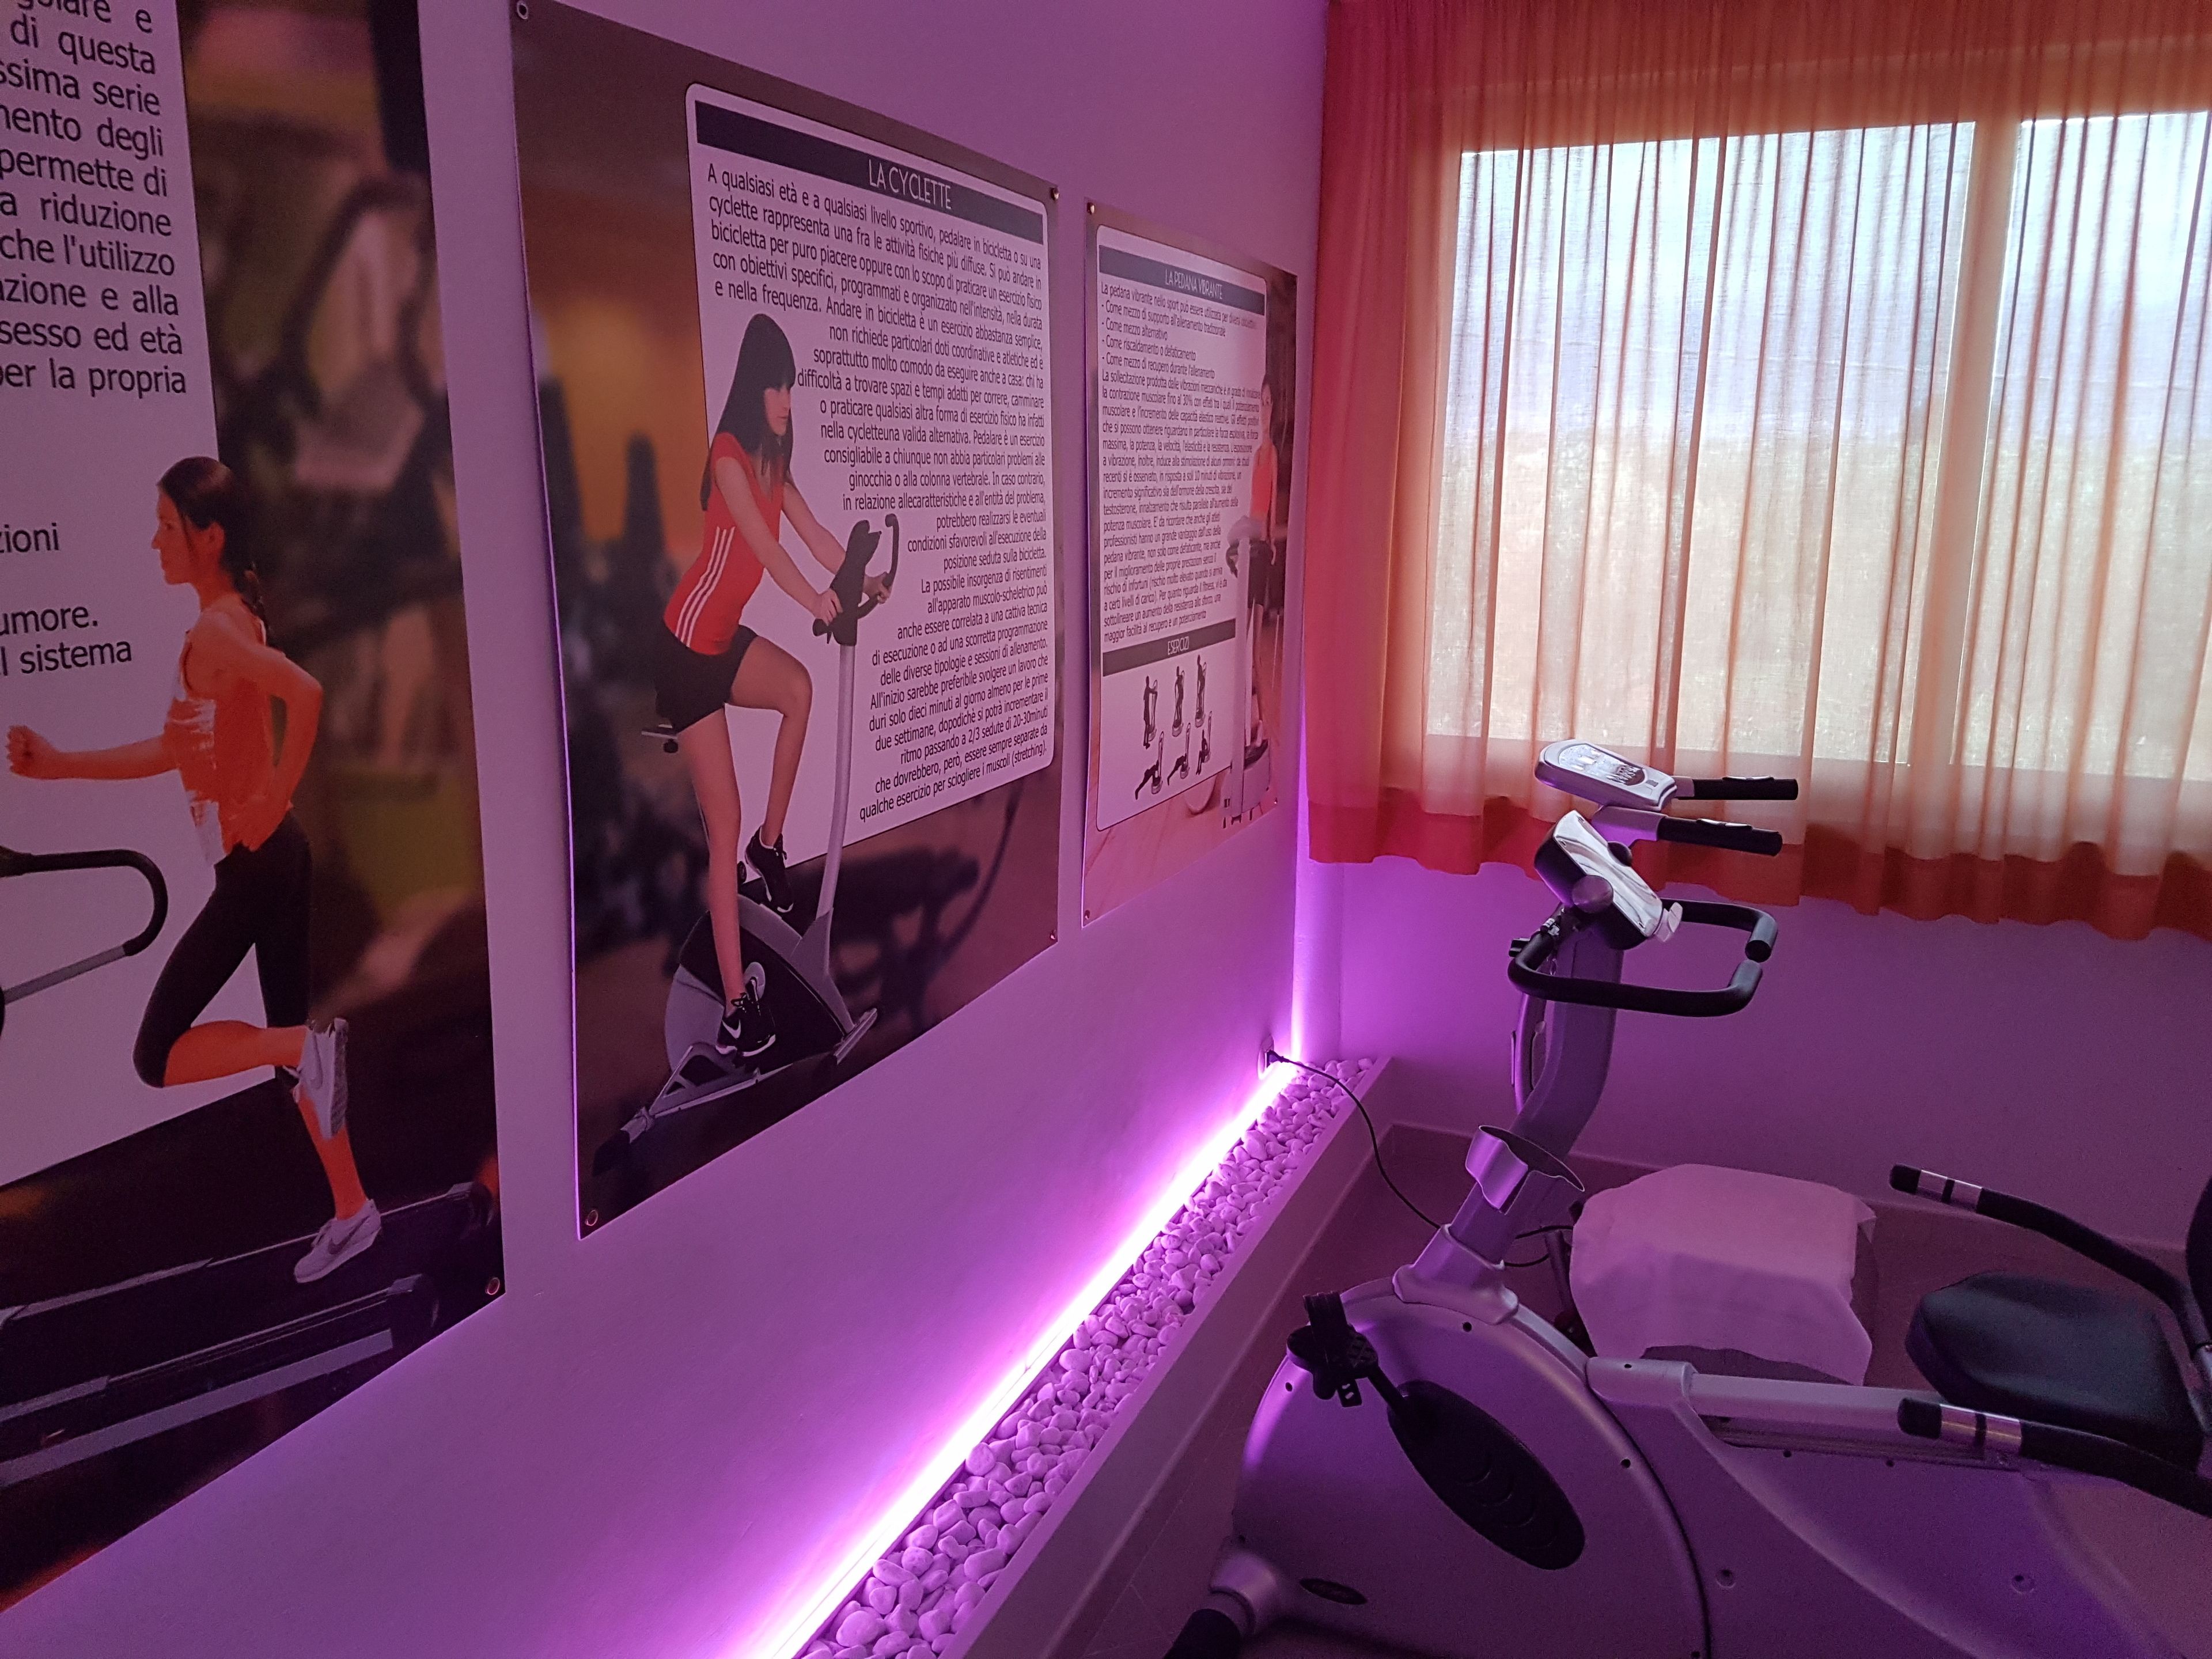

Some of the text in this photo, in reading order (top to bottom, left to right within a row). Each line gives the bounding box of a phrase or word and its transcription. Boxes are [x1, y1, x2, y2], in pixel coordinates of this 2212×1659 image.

[135, 9, 153, 33] e
[10, 13, 156, 74] di questa
[93, 81, 161, 116] serie
[97, 117, 163, 161] degli
[143, 166, 167, 197] di
[869, 159, 952, 210] LA CYCLETTE
[40, 192, 172, 236] riduzione
[63, 234, 175, 276] l'utilizzo
[713, 252, 1042, 330] con obiettivi specifici, programmati e organizzato nell'intensità, nella durata
[1165, 268, 1173, 286] LA
[101, 287, 119, 310] e
[132, 284, 179, 316] alla
[93, 321, 128, 351] ed
[140, 323, 183, 354] età
[49, 357, 75, 389] la
[88, 365, 186, 399] propria
[797, 368, 1044, 408] difficoltà a trovare spazi e tempi adatti per correre, camminare
[824, 446, 1045, 469] consigliabile a chiunque non abbia particolari problemi alle
[843, 489, 1046, 510] in relazione allecaratteristiche e all'entità del problema,
[936, 509, 1046, 532] potrebbero realizzarsi le eventuali
[907, 527, 1046, 552] condizioni sfavorevoli all'esecuzione della
[944, 546, 1046, 574] posizione seduta sulla bicicletta.
[921, 563, 1047, 596] La possibile insorgenza di risentimenti
[927, 580, 1047, 615] all'apparato muscolo-scheletrico può
[20, 641, 132, 674] sistema
[872, 620, 1048, 666] di esecuzione o ad una scorretta programmazione
[880, 637, 1047, 686] delle diverse tipologie e sessioni di allenamento.
[870, 653, 1048, 710] All'inizio sarebbe preferibile svolgere un lavoro che
[859, 740, 1047, 823] qualche esercizio per sciogliere i muscoli (stretching).
